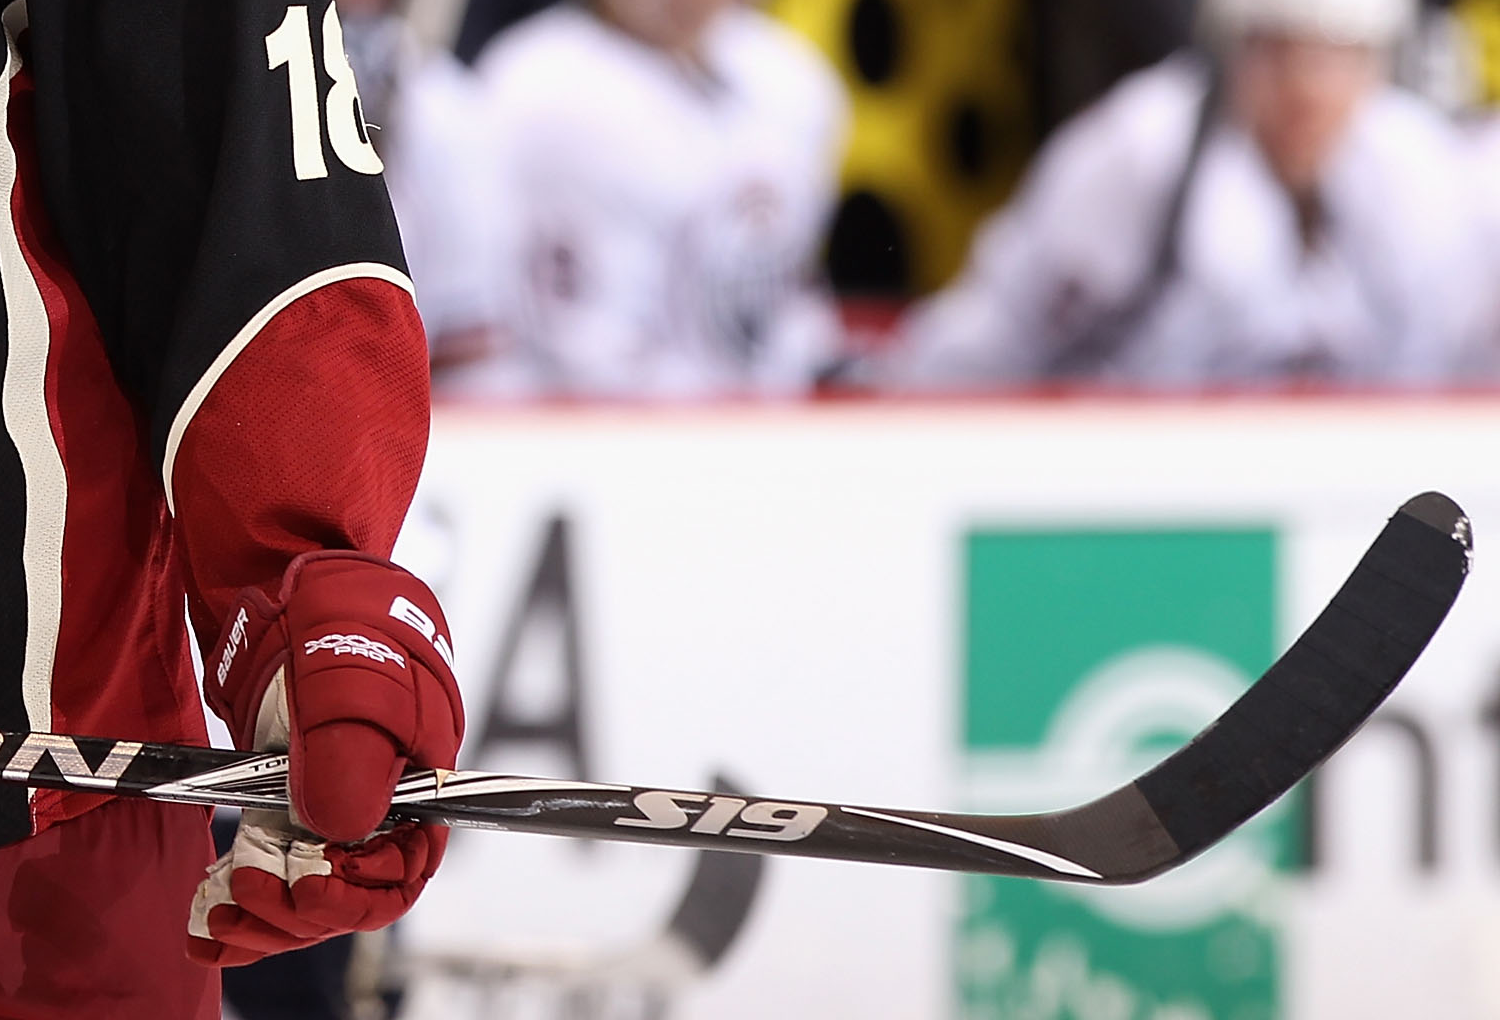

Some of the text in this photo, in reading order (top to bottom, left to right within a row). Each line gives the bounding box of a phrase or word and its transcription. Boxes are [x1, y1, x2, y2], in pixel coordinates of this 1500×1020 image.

[217, 607, 249, 687] BAUER
[334, 646, 386, 663] PRO
[613, 791, 829, 842] S19
